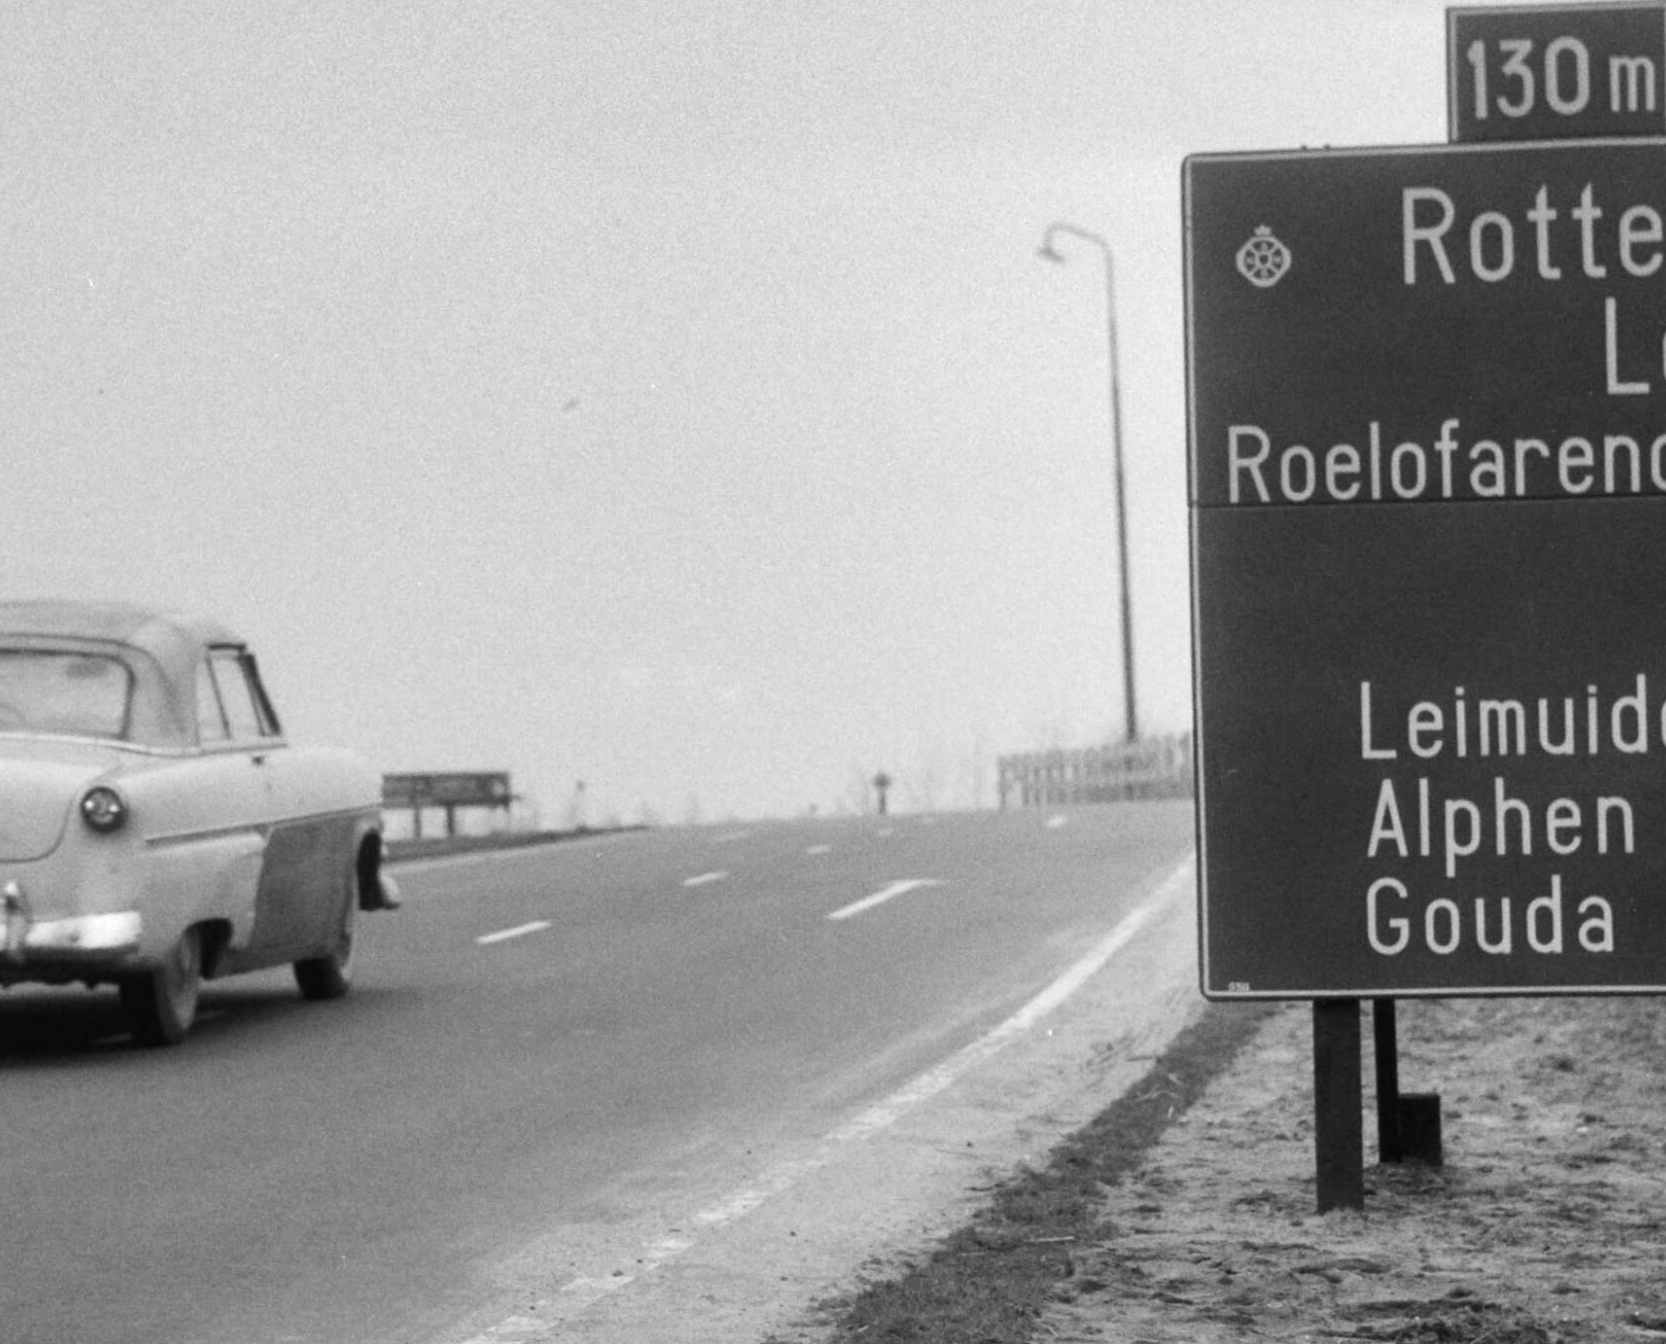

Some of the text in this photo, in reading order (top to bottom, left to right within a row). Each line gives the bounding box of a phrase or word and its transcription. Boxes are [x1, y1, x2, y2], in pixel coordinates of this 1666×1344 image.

[1467, 36, 1656, 119] 130 m
[1366, 776, 1635, 878] Alphen
[1366, 874, 1615, 956] Gouda
